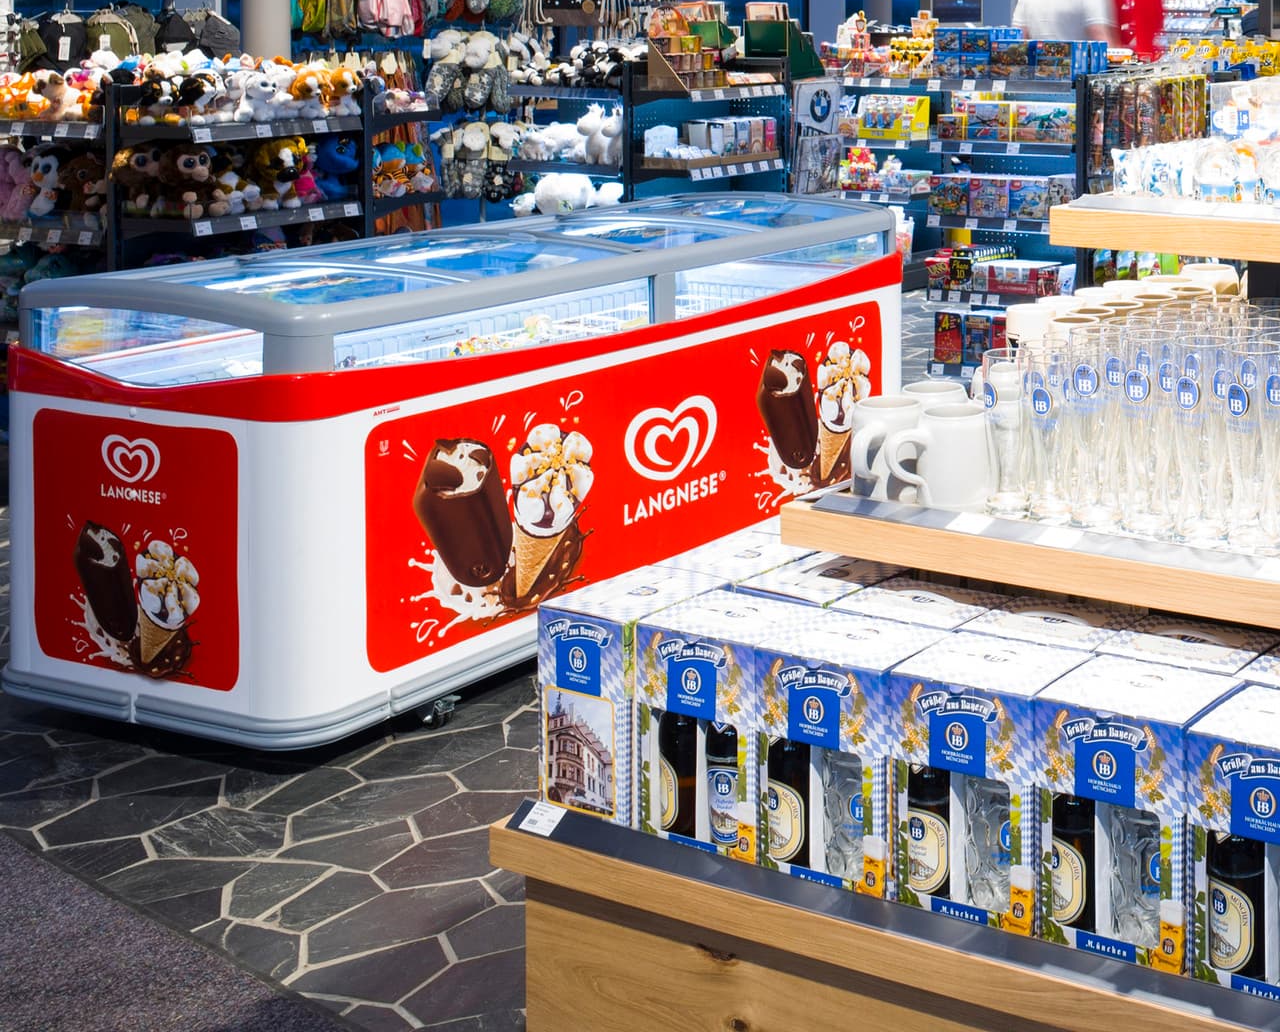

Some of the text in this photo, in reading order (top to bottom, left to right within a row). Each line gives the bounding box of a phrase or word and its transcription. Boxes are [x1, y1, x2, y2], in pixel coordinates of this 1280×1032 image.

[956, 270, 966, 279] 10
[1078, 380, 1092, 392] HB
[1130, 386, 1144, 398] HB
[1180, 392, 1194, 405] HB
[1036, 400, 1047, 412] HB
[1230, 399, 1243, 412] HB
[624, 472, 718, 526] LANGNESE
[569, 626, 579, 636] aus
[682, 647, 695, 656] aus
[574, 658, 584, 668] HB
[686, 680, 697, 690] HB
[781, 670, 842, 689] Grüße aus Bayern
[921, 696, 988, 716] Grüße aus Bayern
[808, 709, 819, 720] HB
[1066, 723, 1138, 744] Grüße aus Bayern
[951, 734, 963, 746] HB
[1099, 764, 1111, 776] HB
[1222, 758, 1247, 772] Grüße
[1250, 763, 1266, 774] aus
[718, 782, 730, 794] HB
[1257, 800, 1270, 814] HB
[911, 827, 922, 839] HB
[1214, 898, 1225, 912] HB
